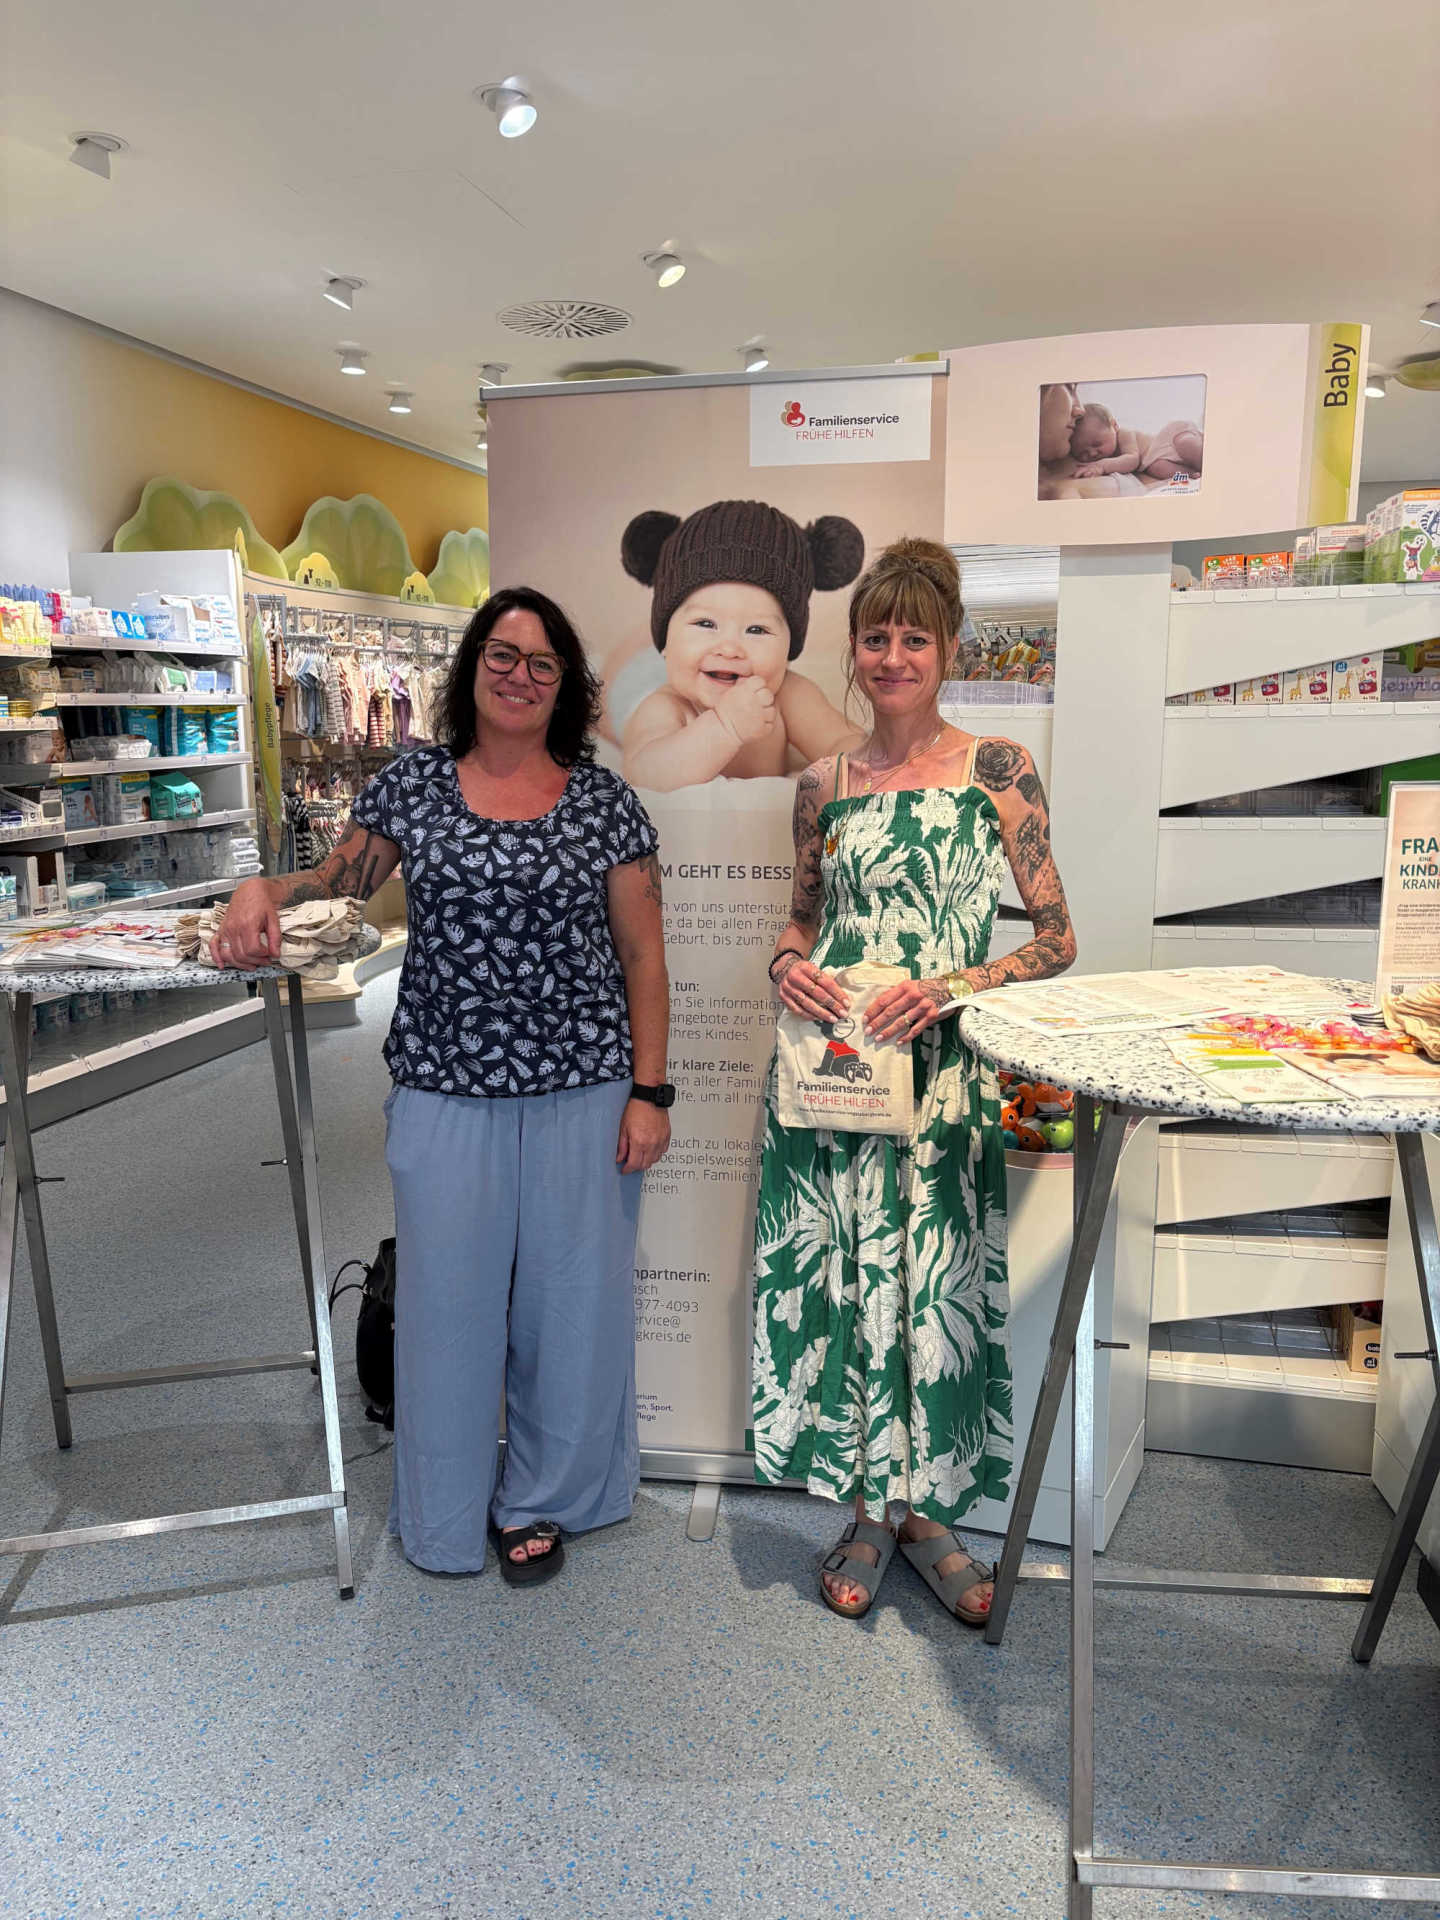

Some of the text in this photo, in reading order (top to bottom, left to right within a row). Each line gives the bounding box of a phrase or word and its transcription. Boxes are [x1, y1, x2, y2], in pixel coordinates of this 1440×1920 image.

[1324, 343, 1356, 407] Baby
[809, 412, 900, 427] Familienservice
[796, 428, 874, 441] FRÜHE HILFEN
[1173, 472, 1188, 481] dm
[264, 703, 273, 748] Babypflege
[1402, 837, 1440, 855] FRA
[660, 864, 796, 880] M GEHT ES BESS
[1400, 864, 1439, 877] KIND
[662, 902, 793, 915] n von uns unterstütz
[677, 916, 692, 928] da
[698, 917, 716, 928] bei
[722, 918, 752, 930] allen
[713, 934, 731, 945] bis
[736, 937, 762, 946] zum
[675, 981, 699, 992] tun:
[685, 997, 704, 1008] Sie
[709, 997, 786, 1011] Information
[733, 1015, 753, 1025] zur
[705, 1028, 751, 1041] Kindes.
[668, 1058, 754, 1073] ir klare Ziele:
[694, 1074, 721, 1088] aller
[797, 1081, 890, 1095] Familienservice
[677, 1089, 696, 1103] lfe,
[701, 1094, 720, 1104] um
[725, 1091, 739, 1104] all
[803, 1092, 885, 1108] FRÜHE HILFEN
[671, 1137, 764, 1151] auch zu lokale
[645, 1169, 760, 1183] western, Familien
[633, 1269, 711, 1282] npartnerin:
[634, 1284, 658, 1295] sch
[635, 1330, 692, 1343] gkreis.de
